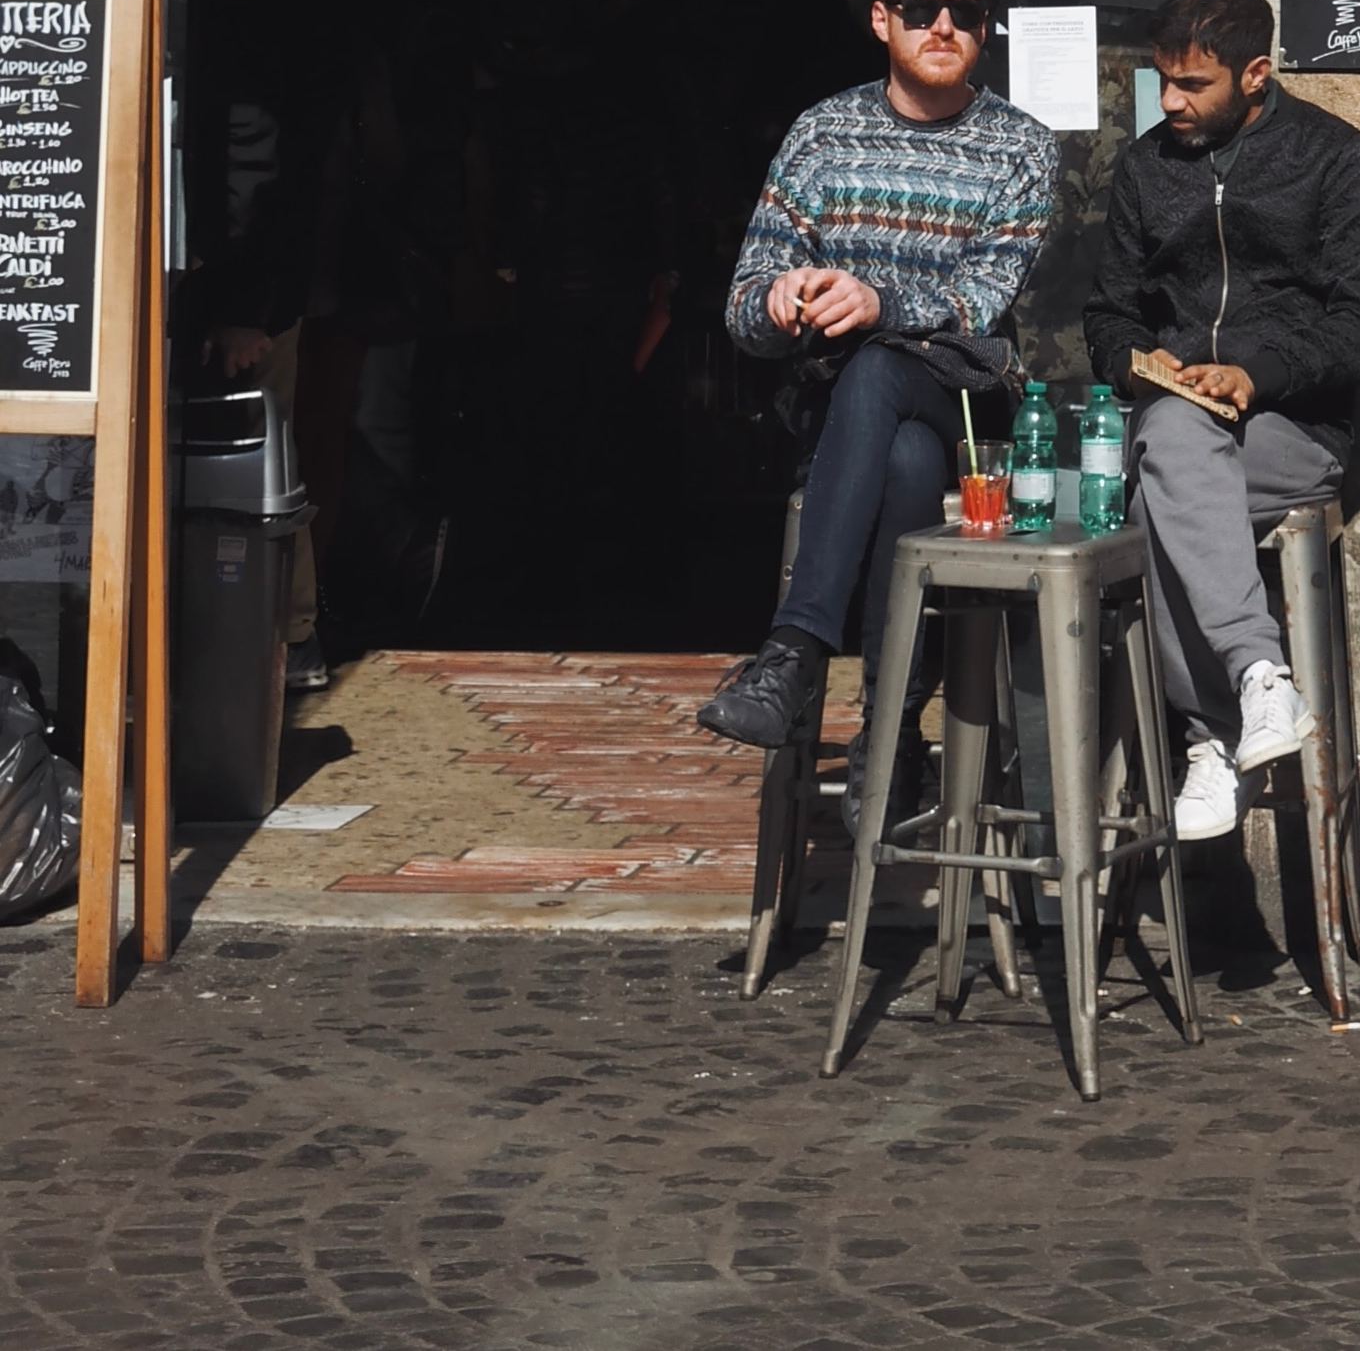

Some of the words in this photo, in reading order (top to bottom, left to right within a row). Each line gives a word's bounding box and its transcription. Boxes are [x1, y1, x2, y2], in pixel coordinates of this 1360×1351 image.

[1, 1, 91, 35] TTERIA
[30, 89, 59, 103] TEA
[0, 157, 83, 176] ROCCHINO
